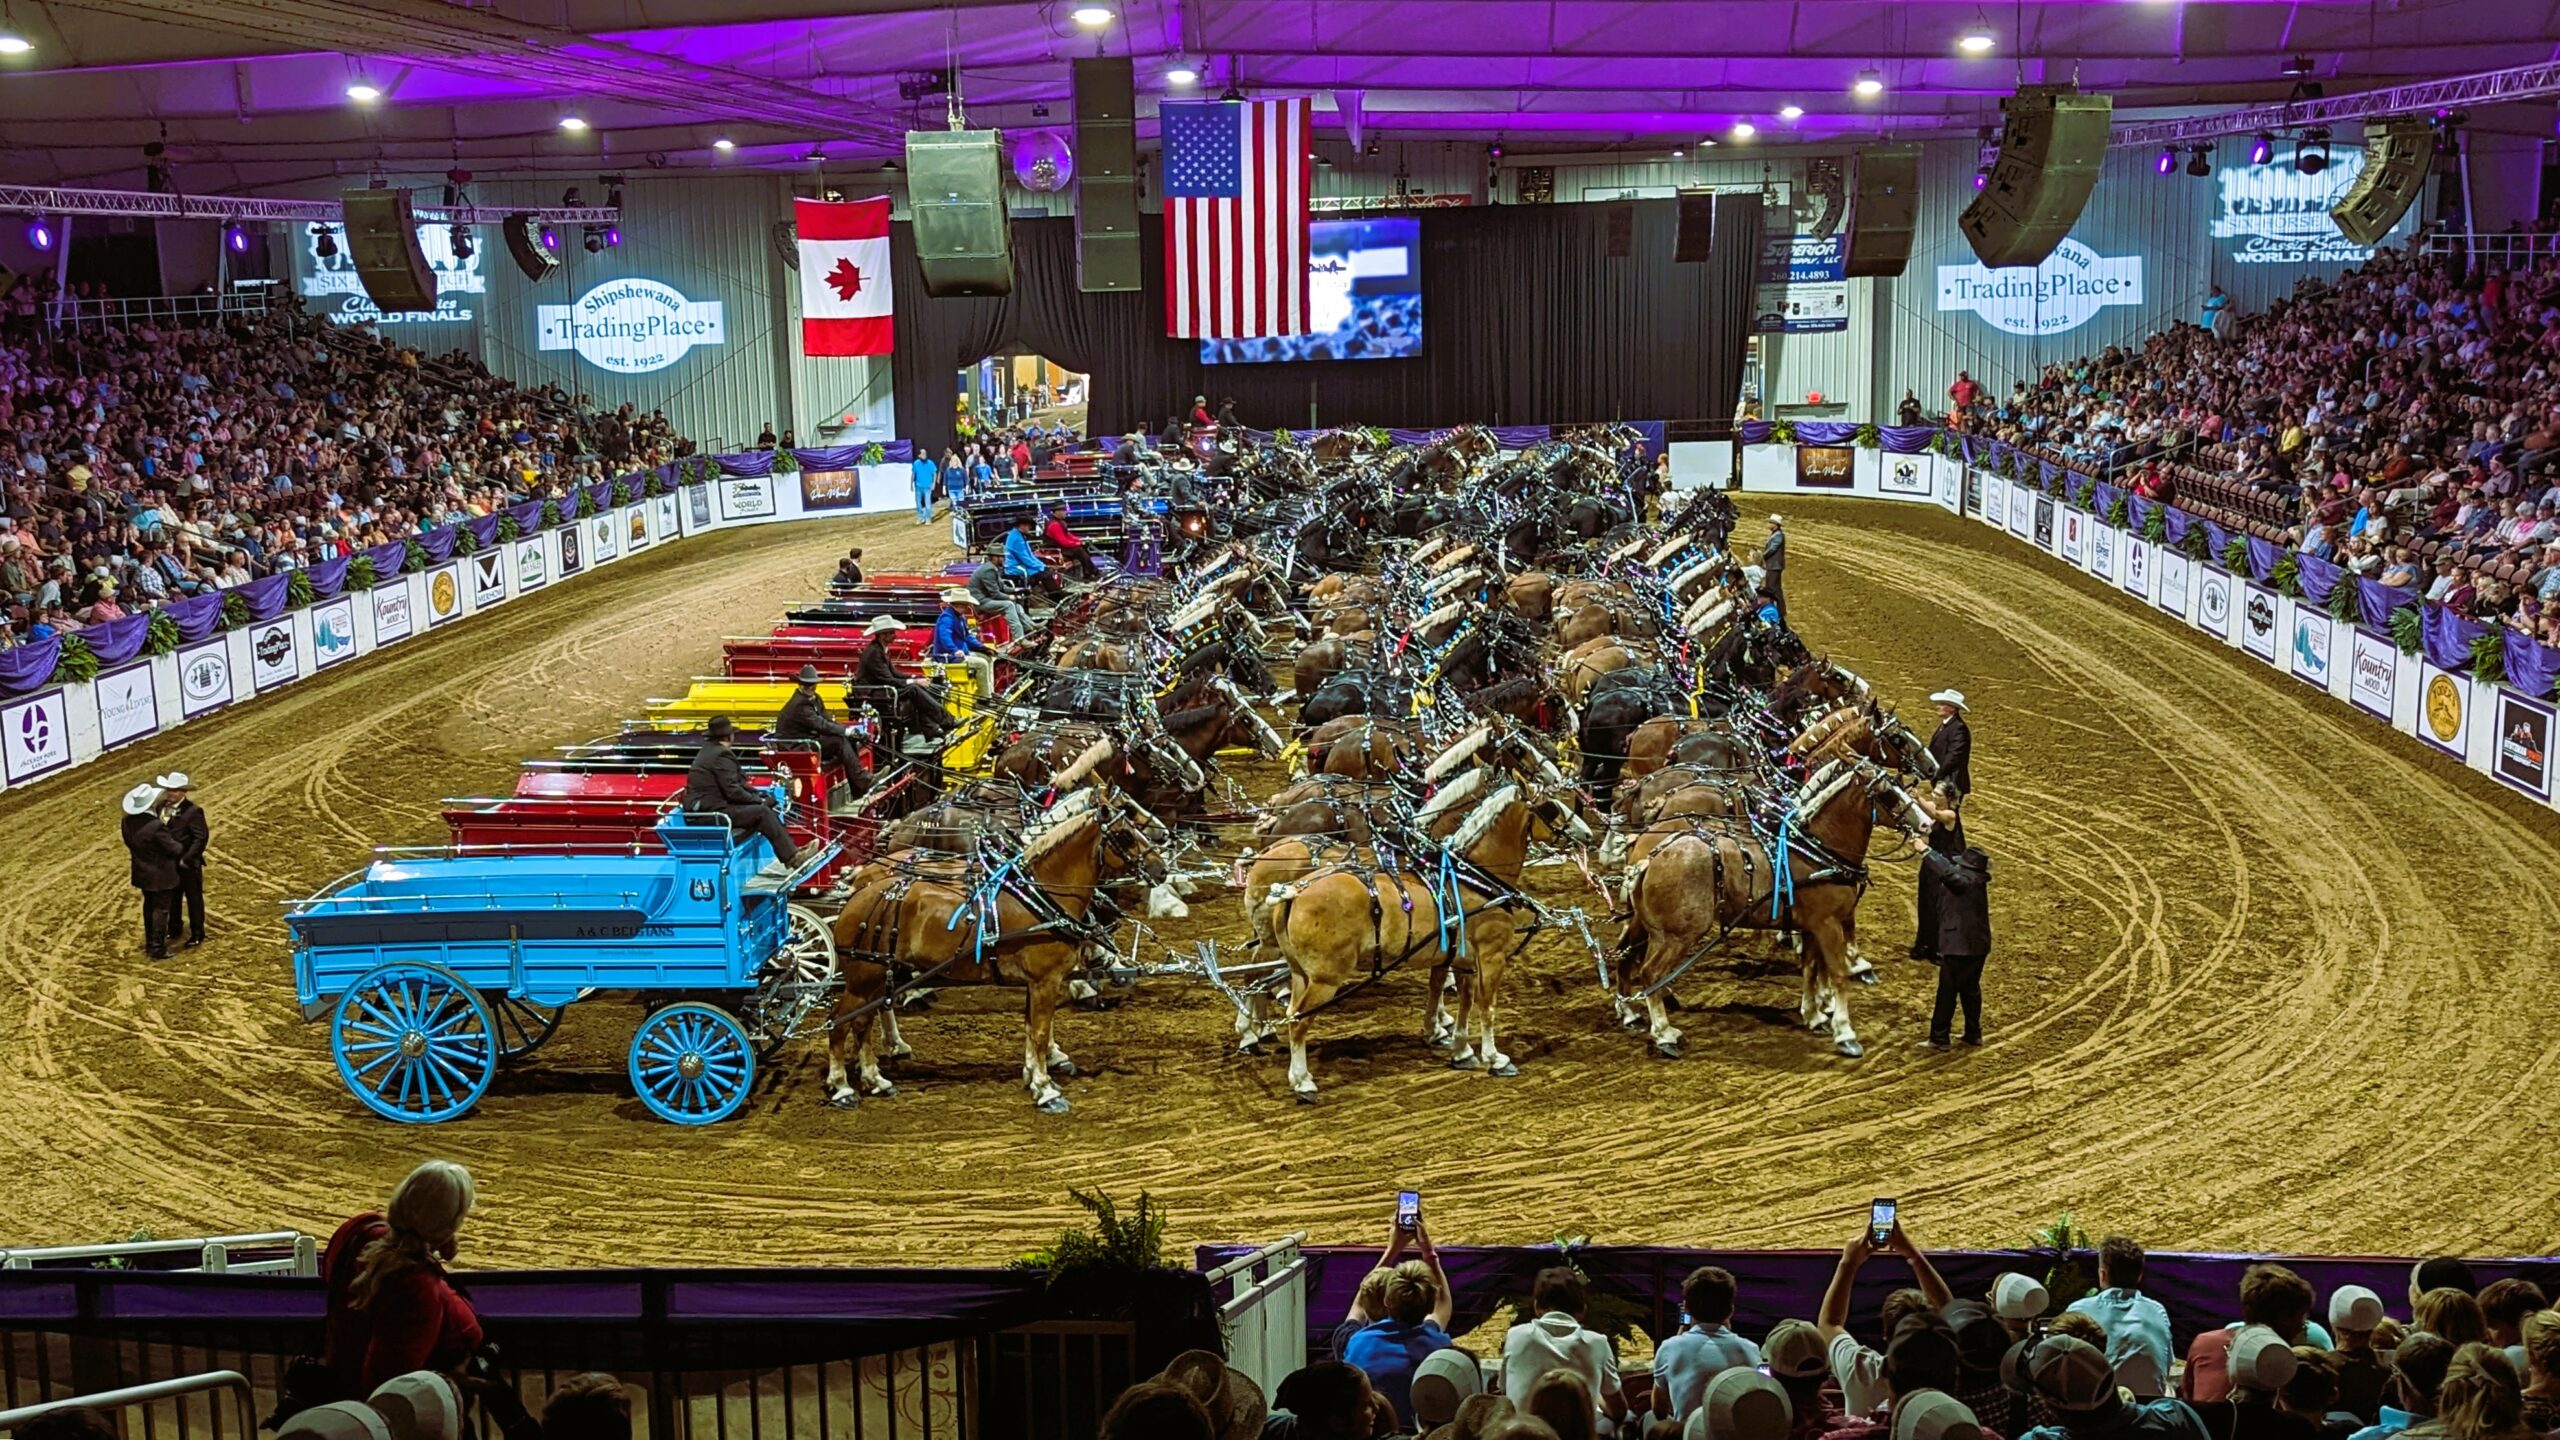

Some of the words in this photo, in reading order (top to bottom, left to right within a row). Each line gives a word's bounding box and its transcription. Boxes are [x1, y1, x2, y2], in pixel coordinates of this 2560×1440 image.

[1763, 243, 1837, 257] SUPERIOR
[2246, 237, 2307, 252] Classic
[1824, 255, 1842, 264] LLC
[2232, 252, 2304, 263] WORLD
[2308, 250, 2376, 261] FINALS
[1955, 272, 2120, 303] TradingPlace
[584, 284, 681, 315] Shipshewana
[330, 312, 403, 325] WORLD
[406, 309, 473, 323] FINALS
[2004, 316, 2030, 329] est.
[555, 315, 705, 343] TradingPlace
[606, 355, 630, 367] est.
[634, 353, 665, 368] 1922
[733, 499, 763, 509] WORLD
[376, 596, 407, 620] Kountry
[2355, 643, 2393, 695] Kountry
[2365, 676, 2380, 691] WOOD
[576, 927, 585, 937] A
[587, 927, 597, 936] &
[600, 927, 609, 937] C
[612, 926, 675, 937] BELGIANS
